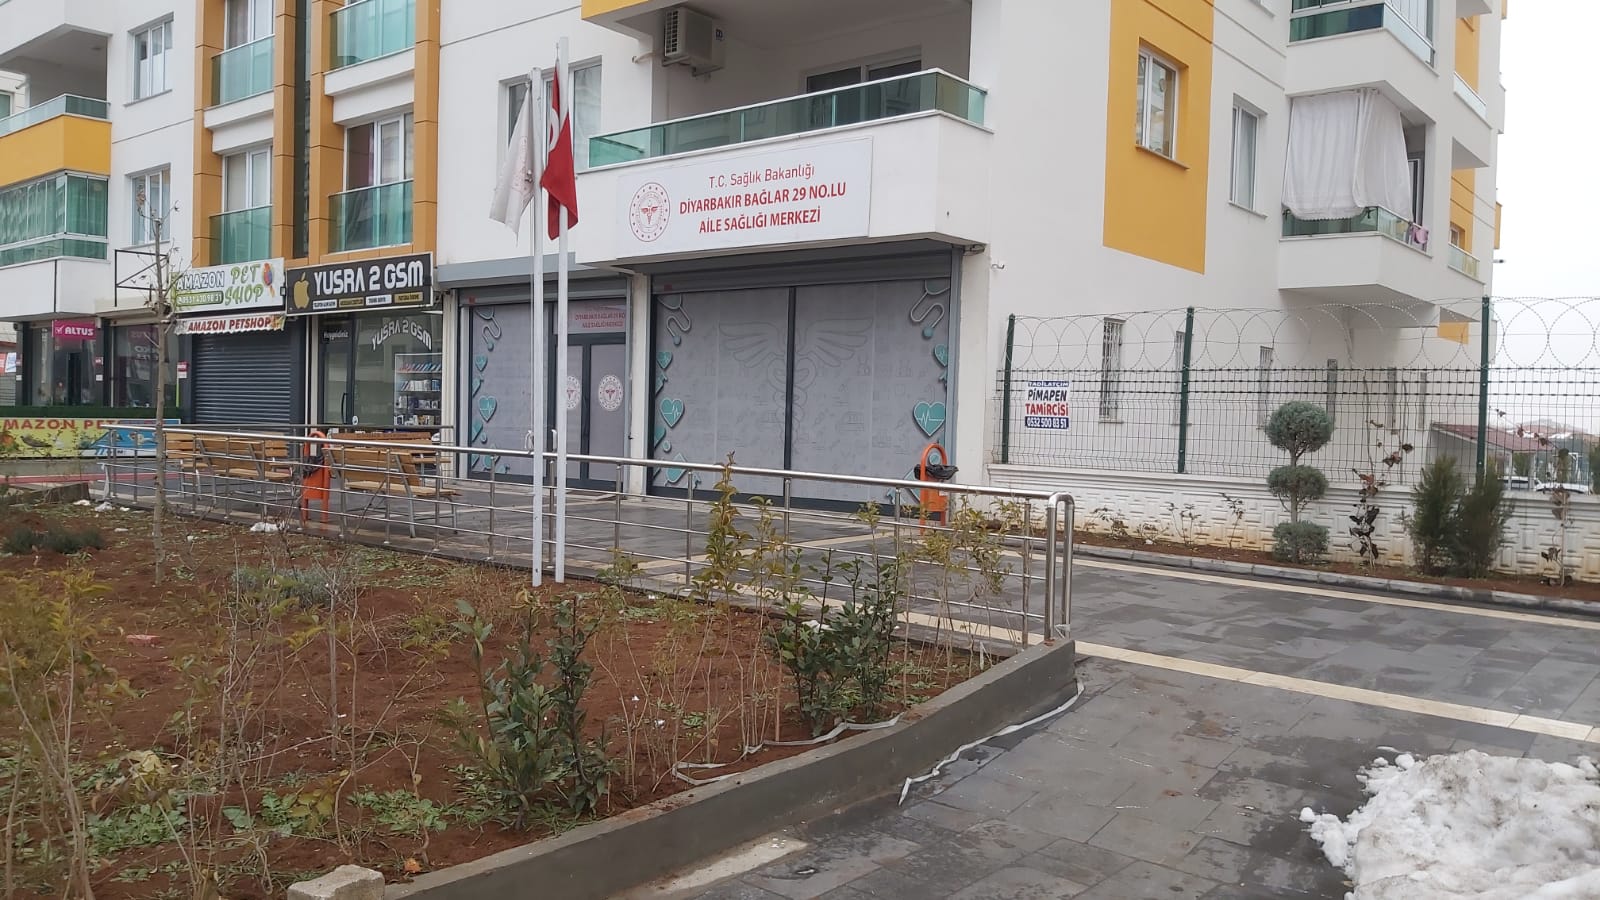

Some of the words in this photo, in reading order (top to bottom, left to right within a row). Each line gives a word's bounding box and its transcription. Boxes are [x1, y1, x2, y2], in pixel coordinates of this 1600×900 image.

[709, 176, 728, 189] T.C.
[730, 171, 762, 187] Sağlık
[764, 163, 815, 182] Bakanlığı
[679, 194, 742, 215] DİYARBAKIR
[744, 189, 790, 207] BAĞLAR
[792, 187, 807, 201] 29
[809, 182, 847, 200] NO.LU
[699, 216, 722, 234] AİLE
[724, 212, 768, 231] SAĞLIĞI
[770, 206, 821, 226] MERKEZİ
[176, 271, 225, 291] AMAZON
[230, 265, 261, 285] PET
[314, 267, 366, 296] YUSRA
[368, 265, 381, 291] 2
[384, 260, 424, 289] GSM
[224, 284, 264, 306] SHOP
[65, 326, 94, 336] ALTUS
[188, 320, 226, 332] AMAZON
[229, 317, 271, 330] PETSHOP
[372, 319, 401, 351] YUSRA
[402, 319, 409, 333] 2
[410, 321, 432, 351] GSM
[0, 419, 75, 430] MAZON
